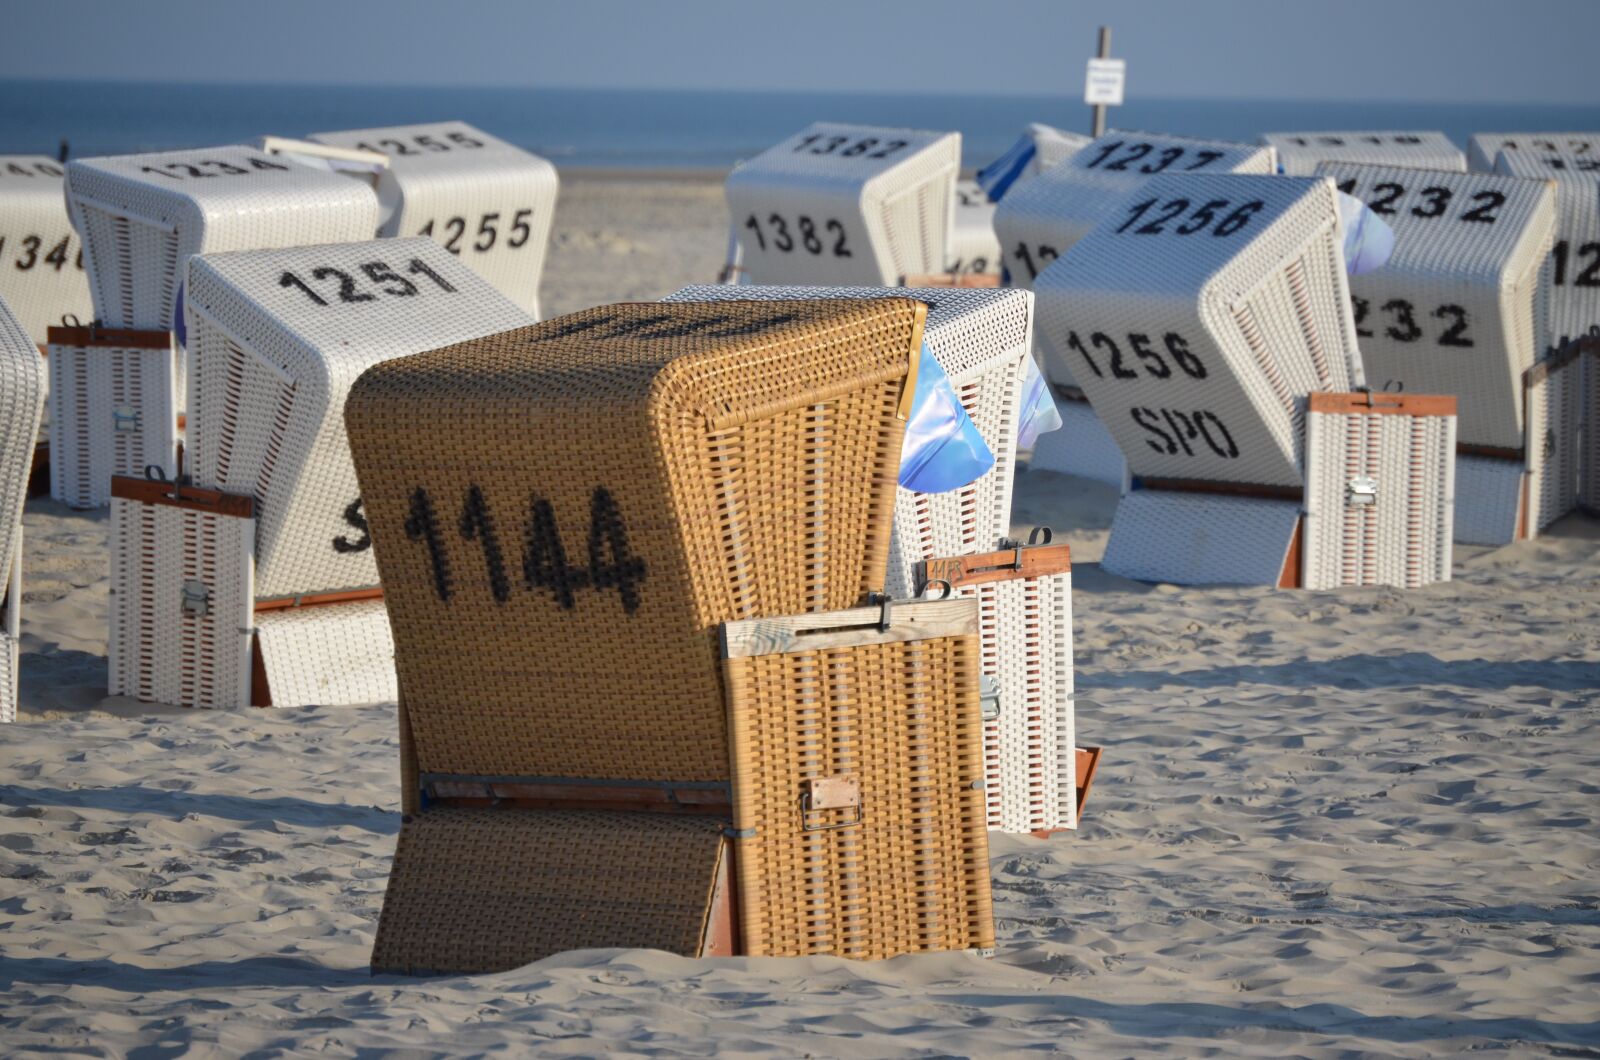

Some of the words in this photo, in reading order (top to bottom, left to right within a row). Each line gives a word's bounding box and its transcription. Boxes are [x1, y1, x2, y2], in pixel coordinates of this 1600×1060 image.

[357, 132, 484, 155] 1255
[795, 133, 909, 158] 1382
[141, 157, 289, 180] 1234
[746, 212, 852, 258] 1382
[1115, 197, 1265, 237] 1256
[280, 257, 458, 306] 1251
[1067, 330, 1208, 379] 1256
[1130, 407, 1240, 459] SPO
[405, 484, 647, 615] 1144
